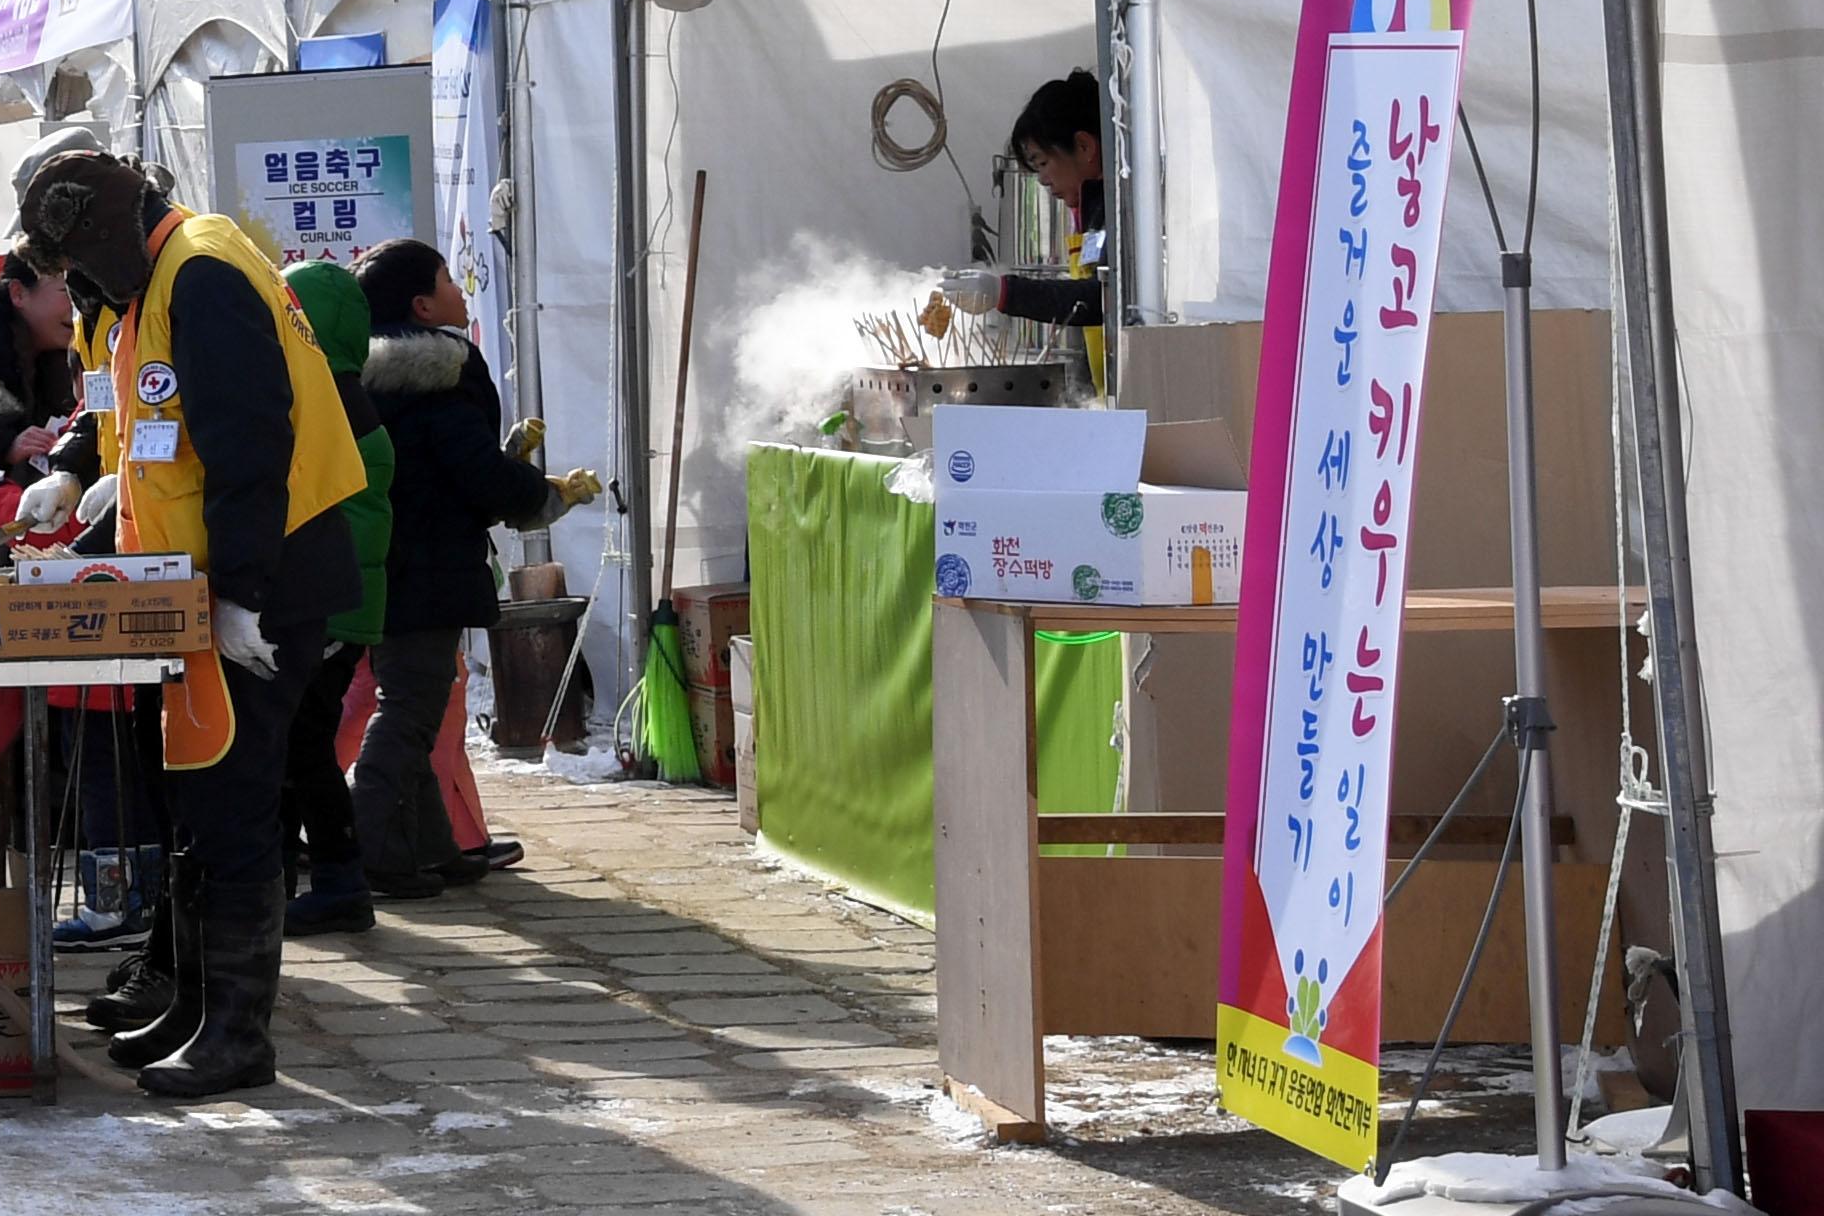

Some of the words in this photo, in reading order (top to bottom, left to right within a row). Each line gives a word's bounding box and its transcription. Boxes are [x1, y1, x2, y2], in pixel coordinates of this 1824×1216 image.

[264, 147, 382, 184] 얼음축구
[289, 183, 308, 195] ICE
[310, 180, 359, 194] SOCCER
[1380, 95, 1440, 330] 낳고
[299, 231, 353, 244] CURLING
[1333, 118, 1372, 387] 즐거운
[991, 536, 1021, 557] 화천
[992, 558, 1054, 580] 장수떡방
[1311, 429, 1352, 590] 세상
[1346, 378, 1412, 738] 키우는
[1288, 630, 1333, 873] 만들기
[1327, 763, 1366, 928] 일이
[1226, 1041, 1238, 1078] 한
[1237, 1047, 1257, 1088] 자녀
[1257, 1056, 1268, 1092] 더
[1286, 1069, 1326, 1118] 운동연합
